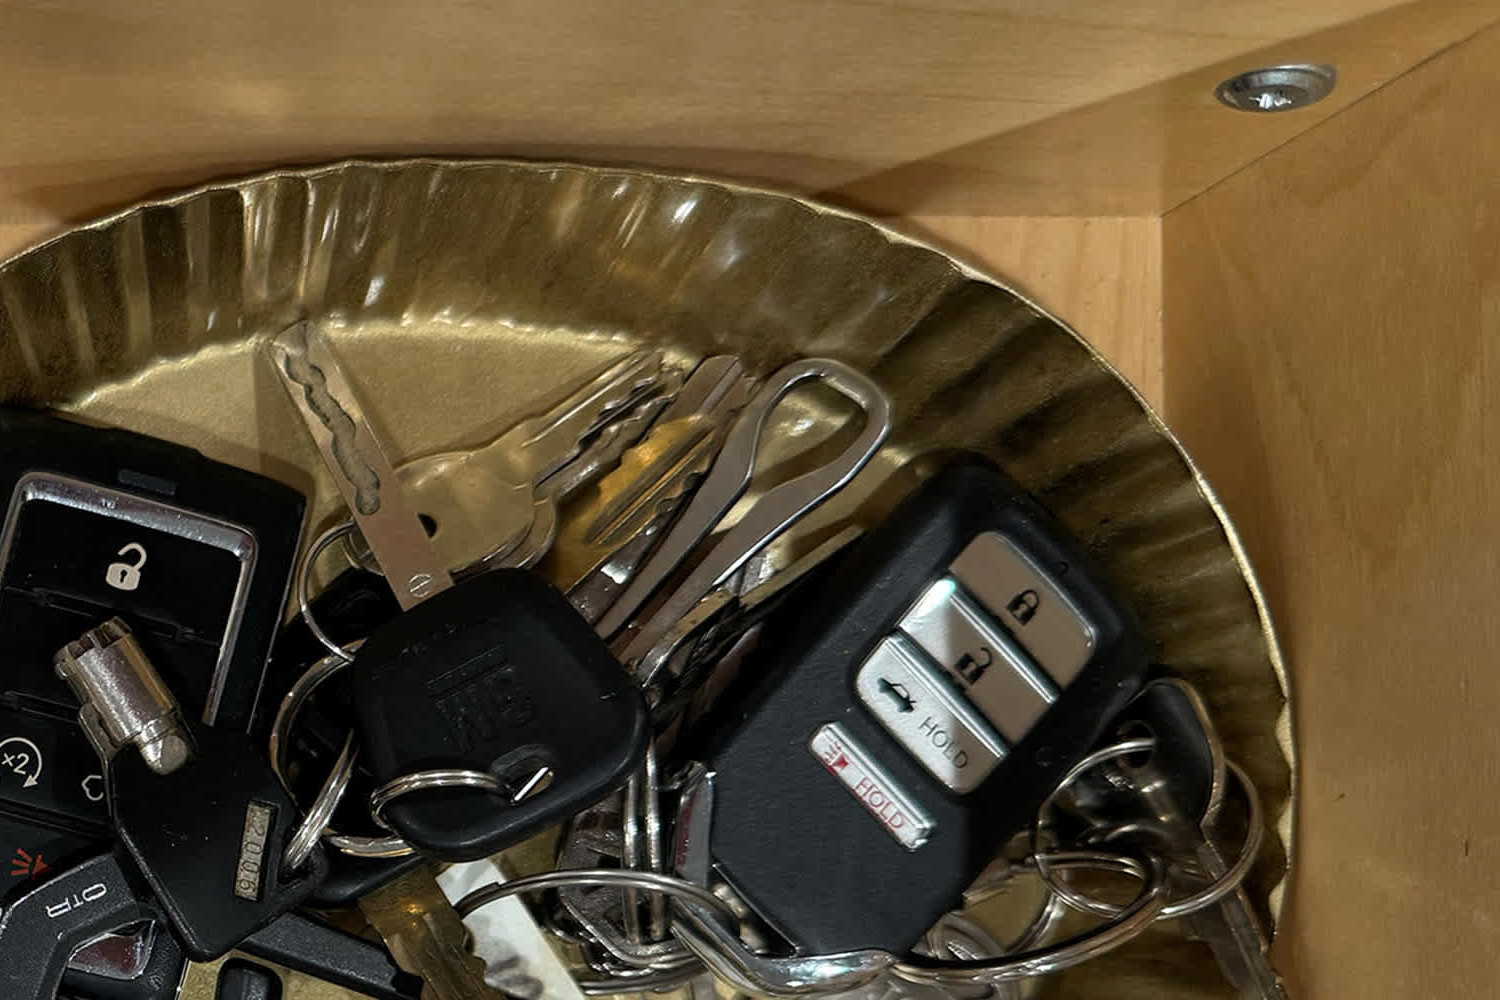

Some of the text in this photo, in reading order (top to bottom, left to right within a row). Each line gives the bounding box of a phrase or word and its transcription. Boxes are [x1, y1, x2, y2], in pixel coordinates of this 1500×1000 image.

[918, 716, 969, 769] HOLD
[854, 777, 905, 829] HOLD
[45, 883, 107, 918] OTR
